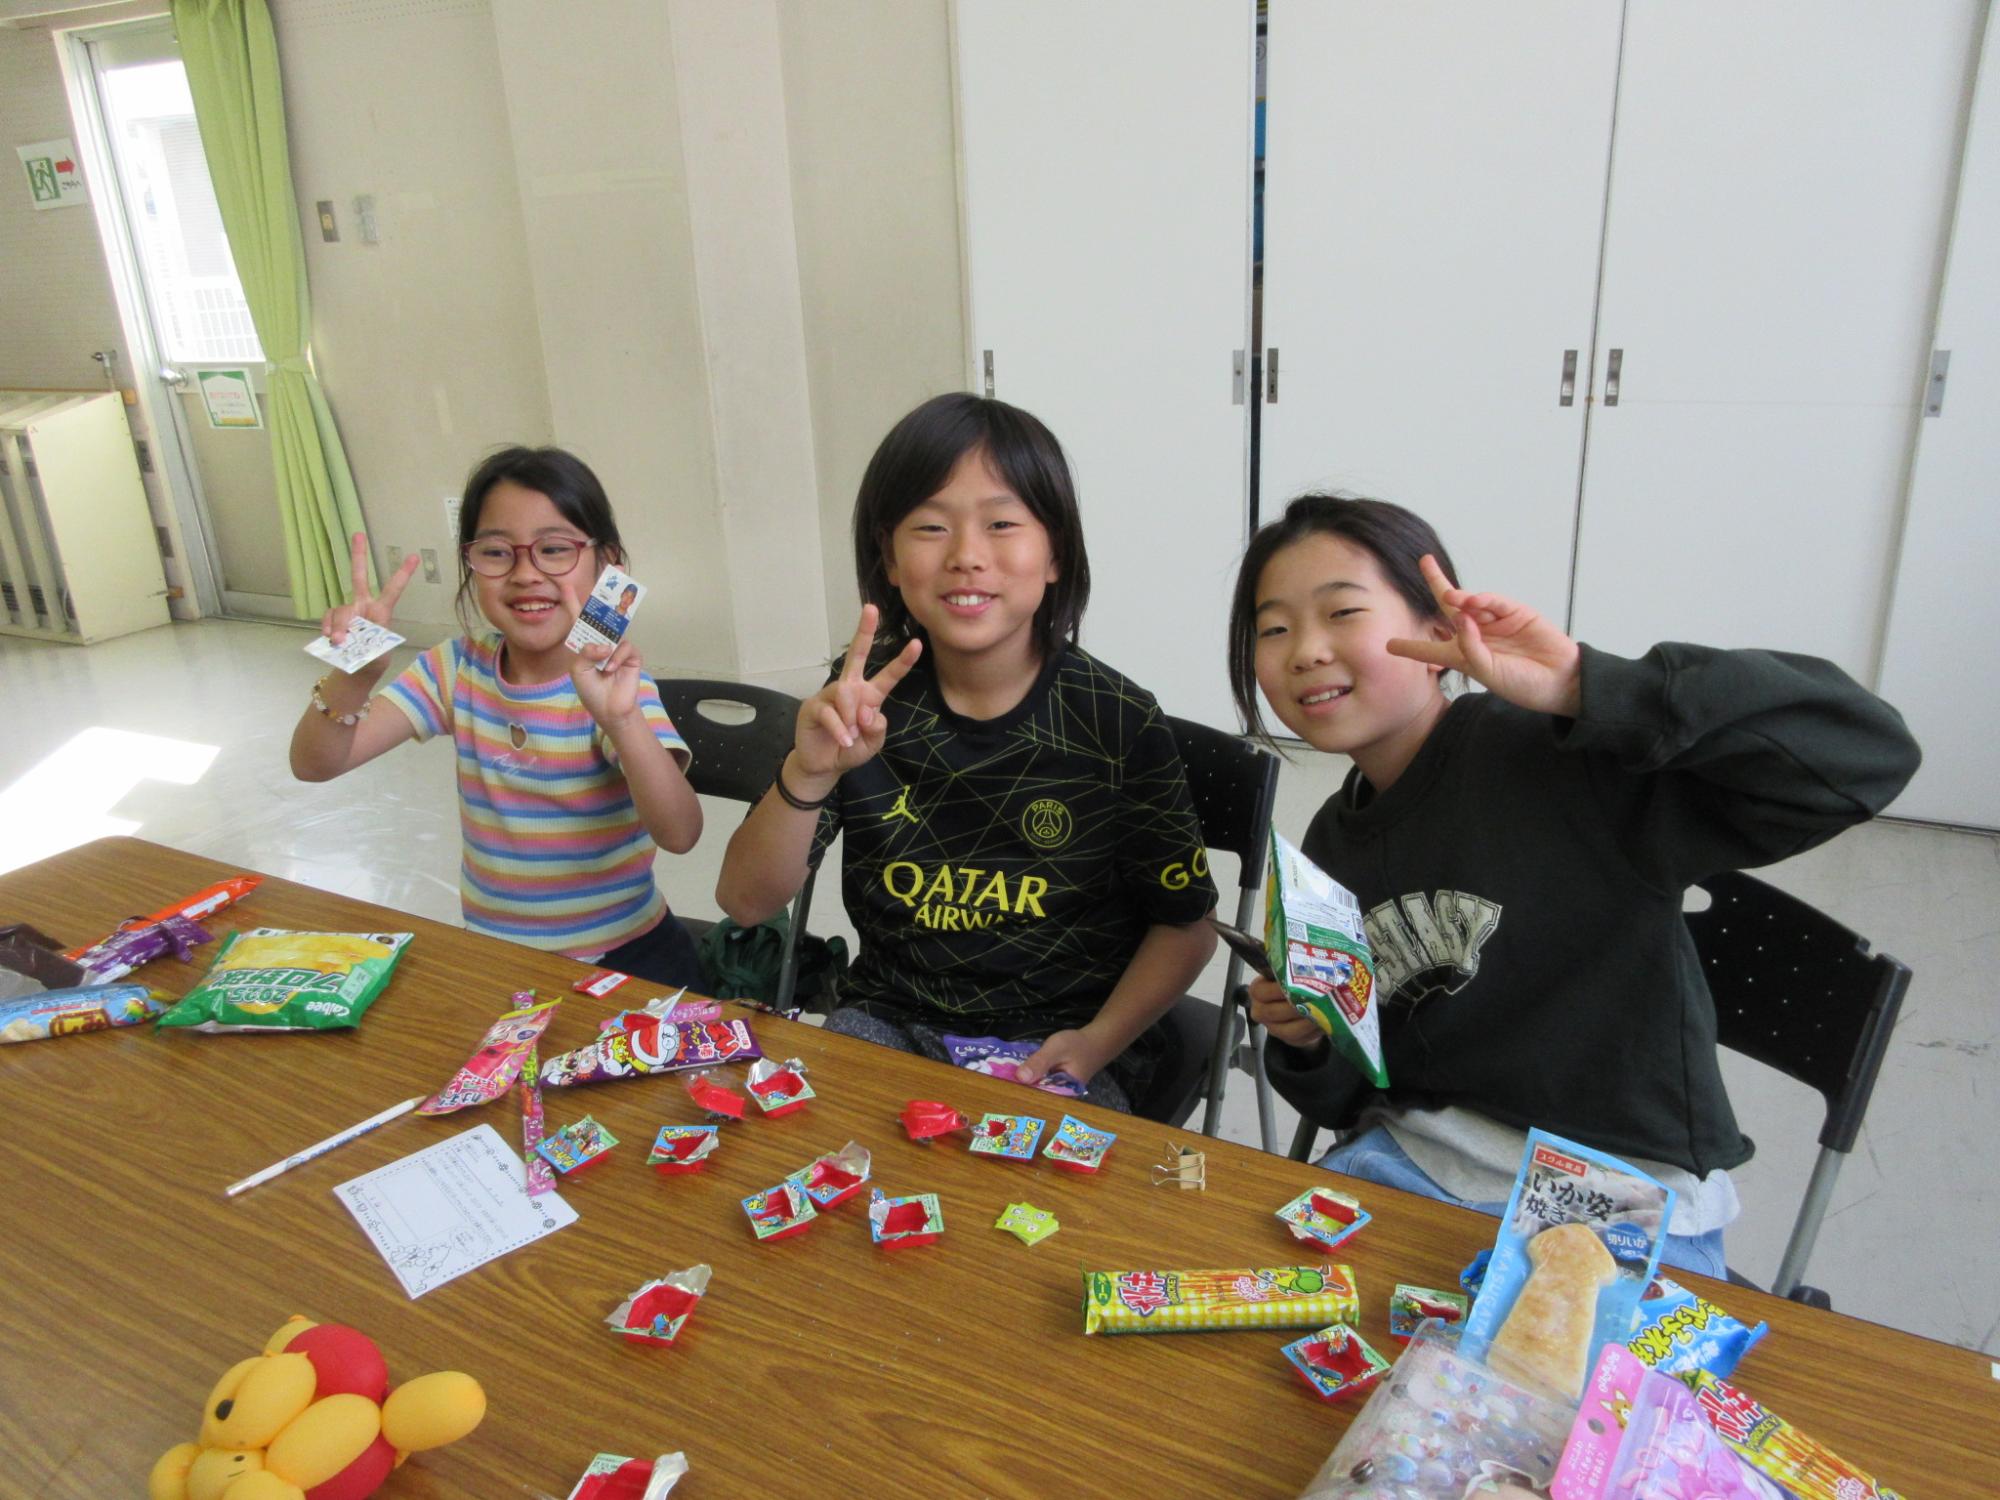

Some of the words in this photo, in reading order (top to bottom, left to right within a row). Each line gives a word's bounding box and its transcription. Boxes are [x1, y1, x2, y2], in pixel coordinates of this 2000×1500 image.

[1032, 801, 1064, 815] PARIS
[883, 861, 1048, 919] QATAR
[914, 902, 1029, 932] AIRW
[226, 983, 290, 1005] 2025
[303, 1001, 351, 1019] Calbee
[1523, 1194, 1567, 1223] 焼き
[1532, 1172, 1614, 1222] いか姿
